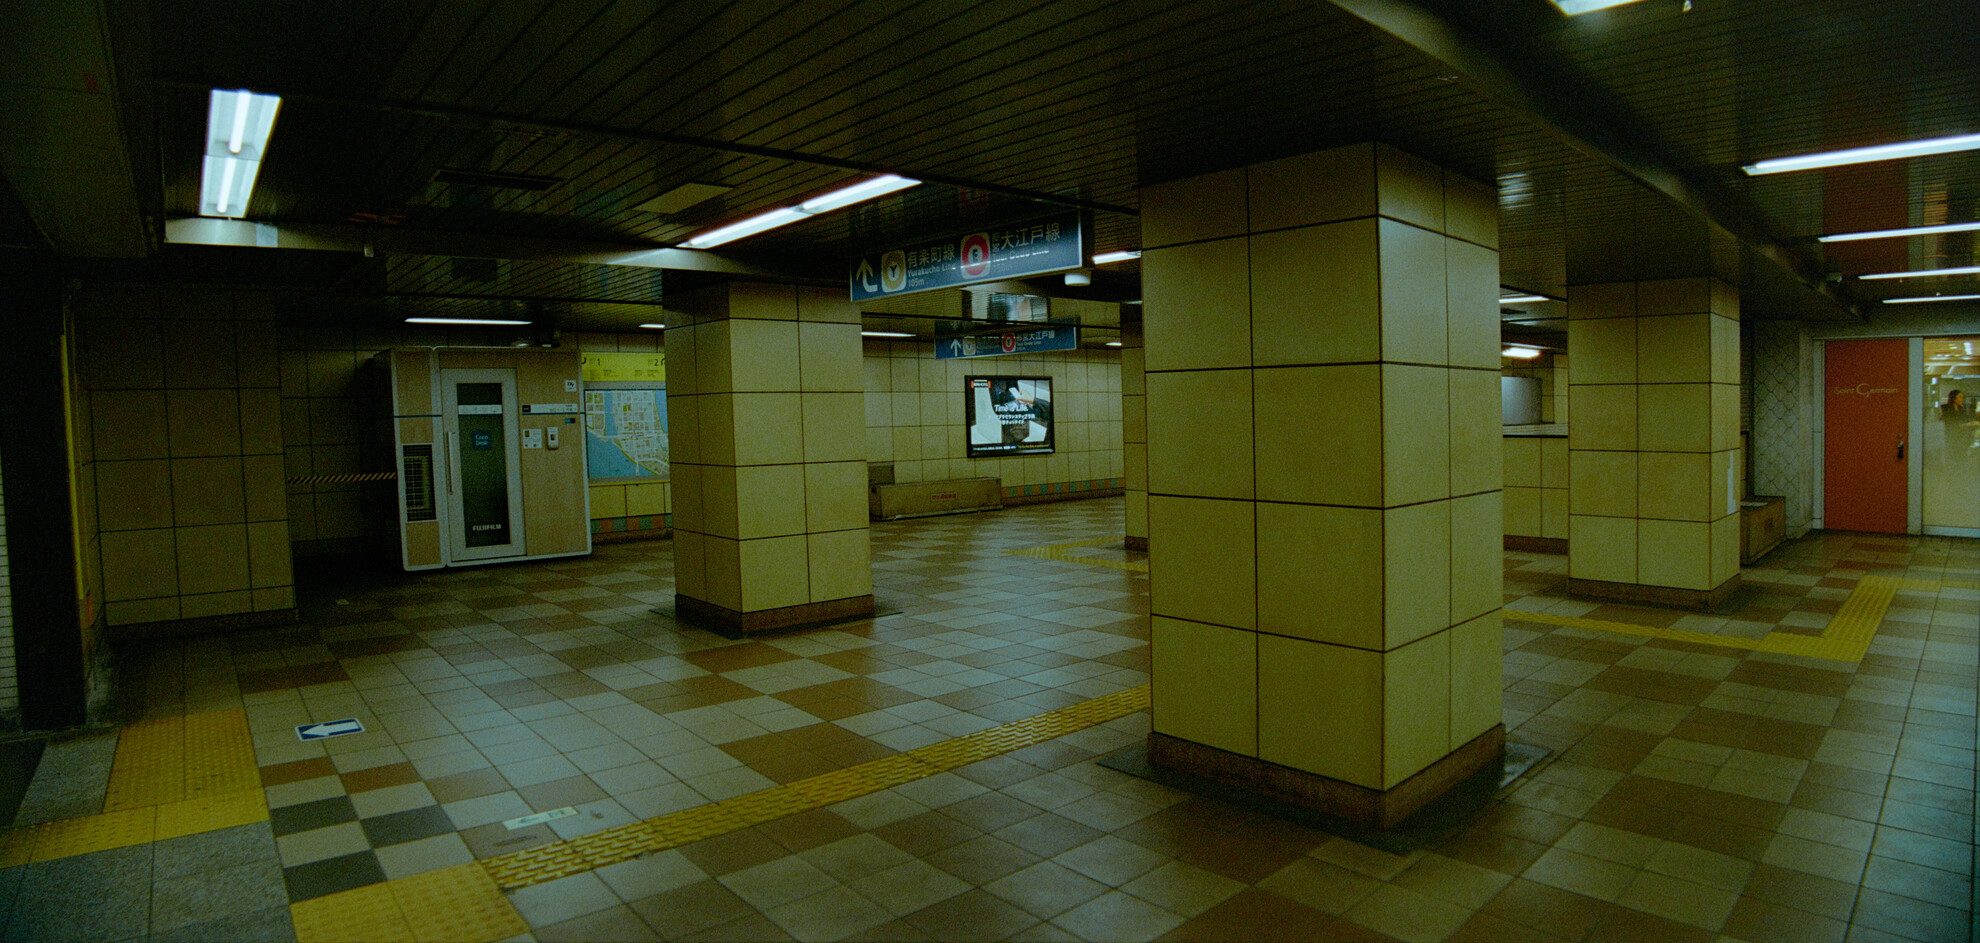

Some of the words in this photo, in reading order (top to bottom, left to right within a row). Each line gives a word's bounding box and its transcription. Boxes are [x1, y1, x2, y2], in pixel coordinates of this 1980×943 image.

[1001, 222, 1061, 250] 大江戸線
[907, 243, 955, 268] 有楽町線
[889, 265, 898, 278] Y
[907, 264, 941, 278] Yurakucho
[654, 358, 659, 367] 2
[1833, 386, 1855, 395] Saint
[1856, 382, 1899, 398] Germain
[472, 523, 502, 532] FUJIFILM
